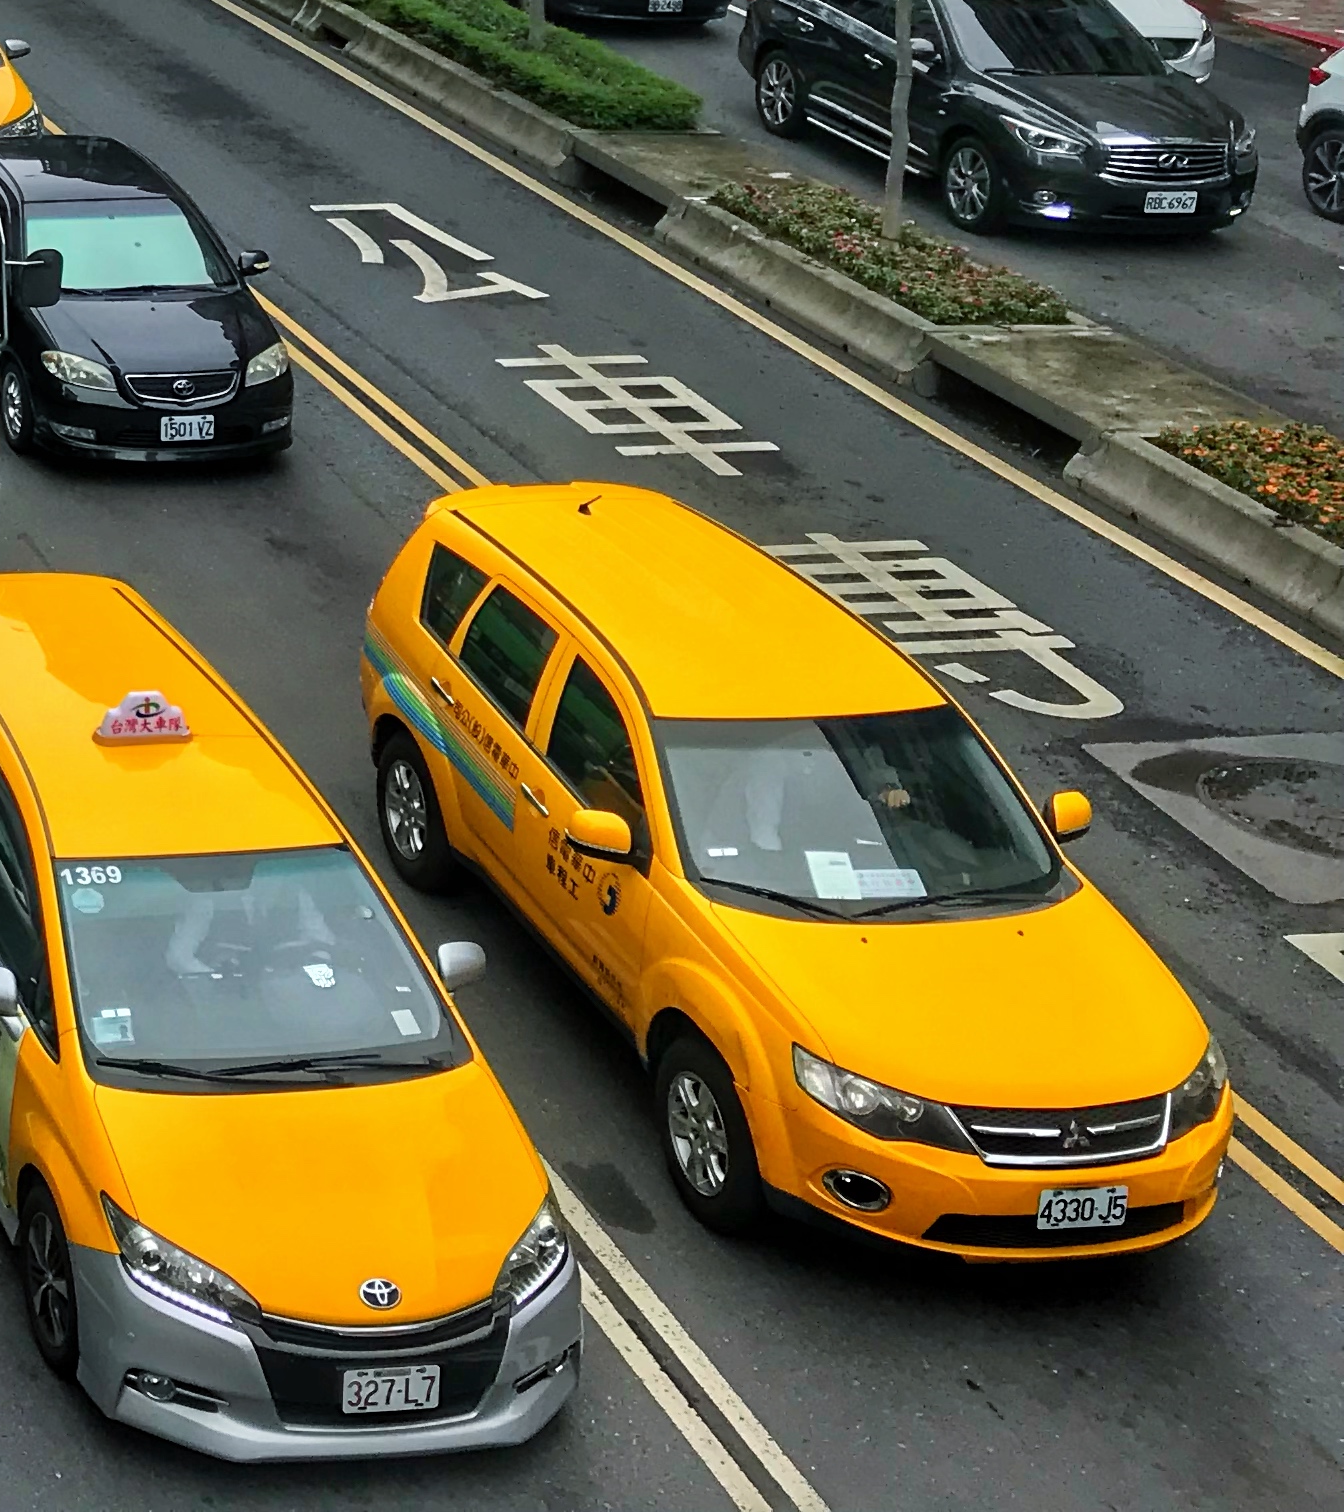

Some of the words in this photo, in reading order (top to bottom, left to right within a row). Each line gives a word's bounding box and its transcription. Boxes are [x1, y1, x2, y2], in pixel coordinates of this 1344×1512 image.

[163, 420, 214, 439] 1501-VZ
[110, 716, 184, 735] 台灣大車隊
[60, 865, 123, 886] 1369
[1039, 1195, 1127, 1224] 4330-J5
[347, 1375, 436, 1408] 327-L7
